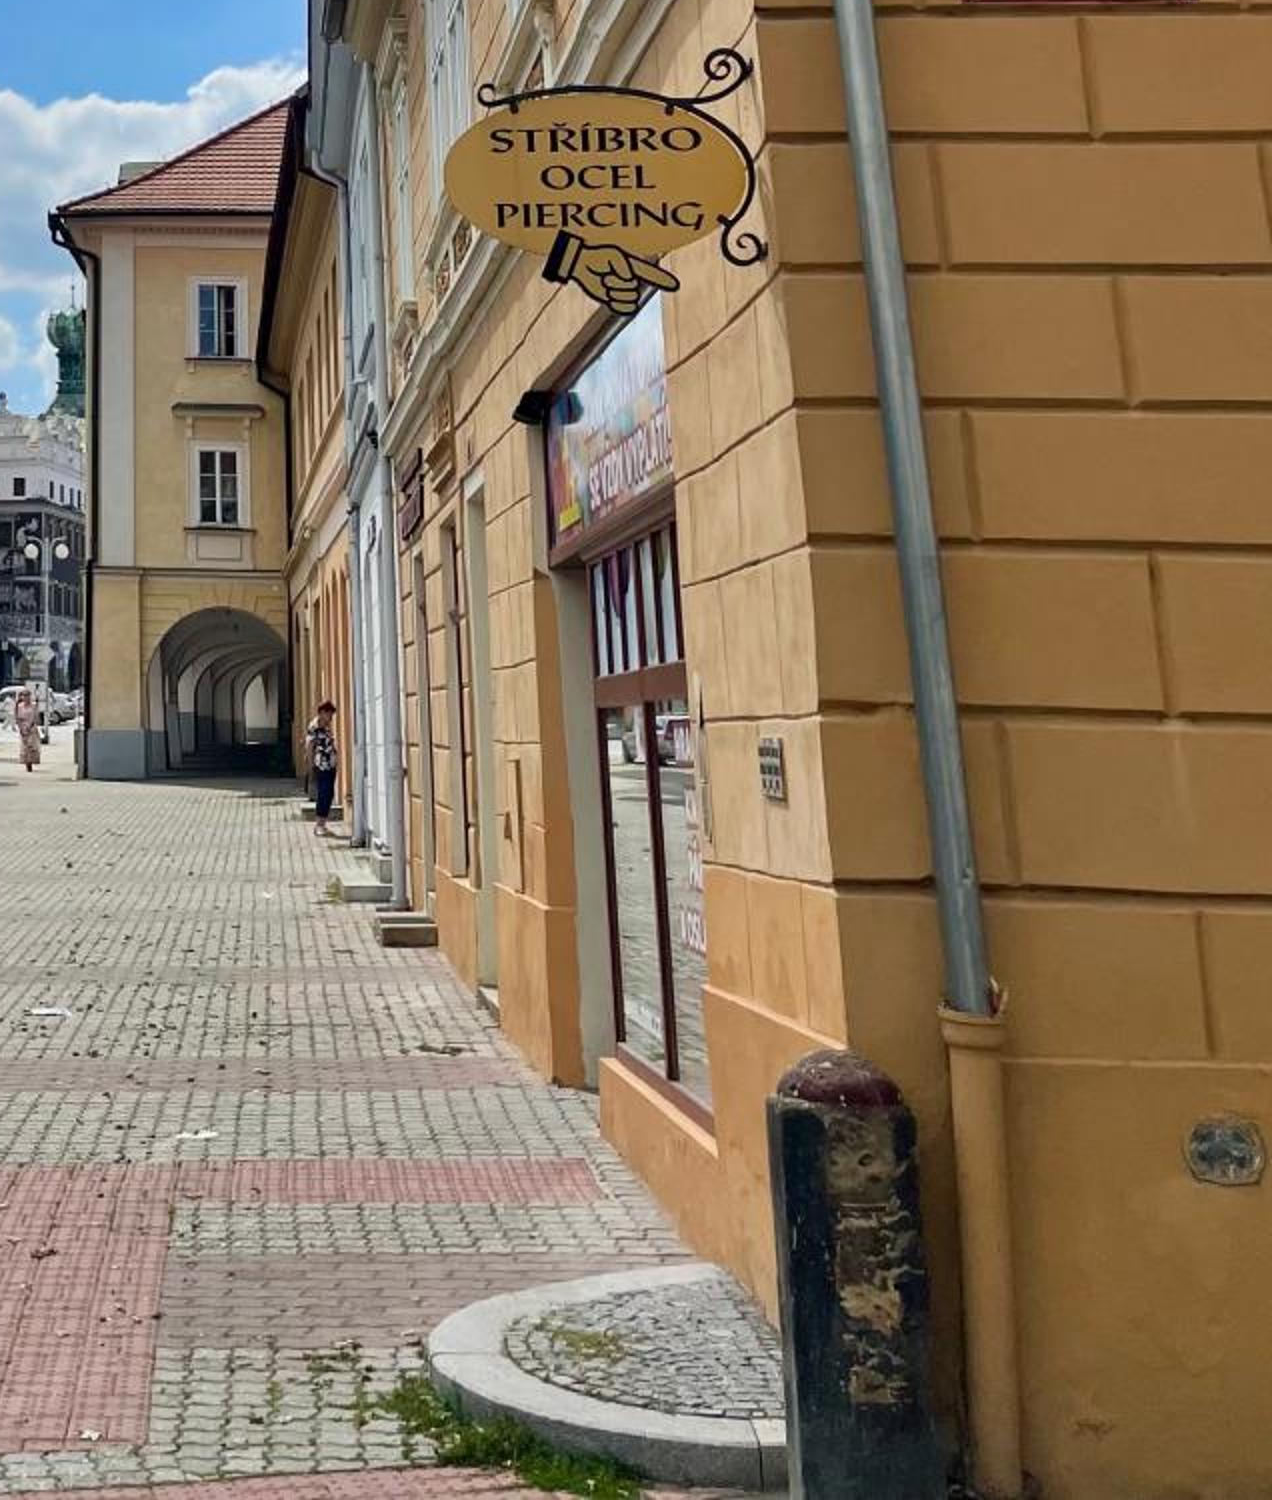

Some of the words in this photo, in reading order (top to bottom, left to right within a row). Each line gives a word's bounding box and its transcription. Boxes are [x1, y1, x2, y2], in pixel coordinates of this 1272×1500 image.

[489, 122, 702, 152] STŘÍBRO
[540, 164, 656, 189] OCEL
[495, 202, 705, 230] PIERCING
